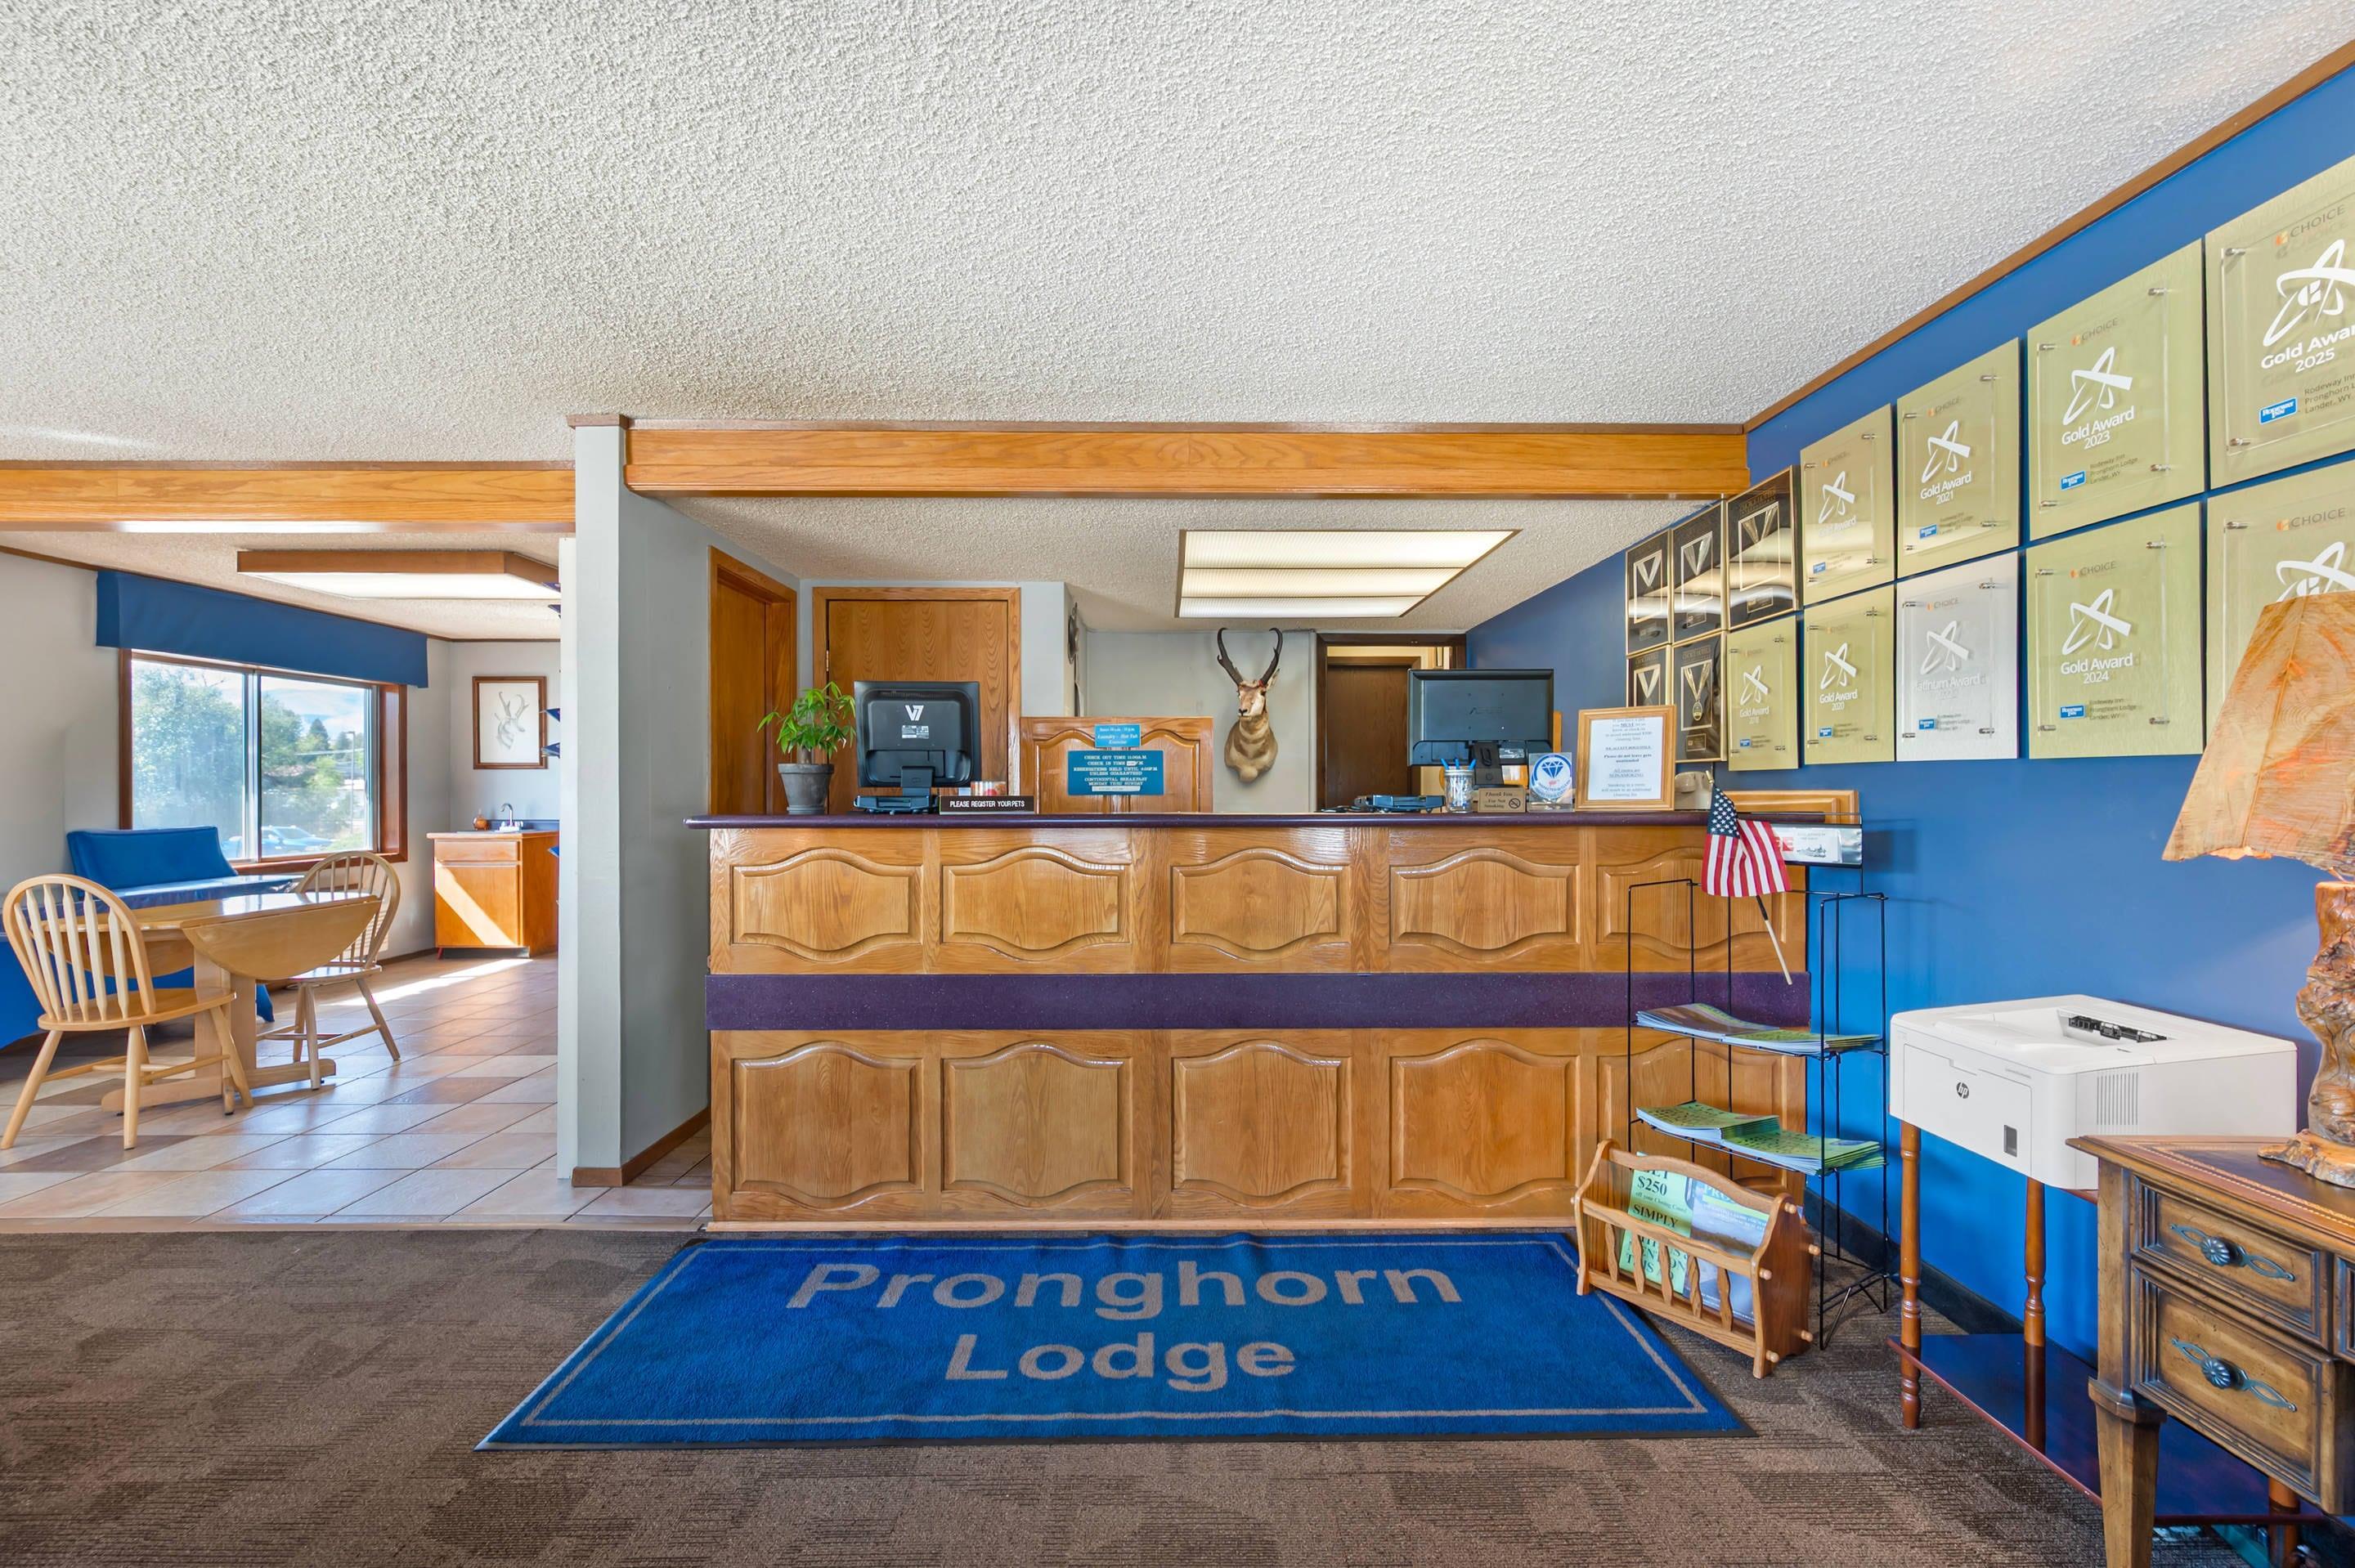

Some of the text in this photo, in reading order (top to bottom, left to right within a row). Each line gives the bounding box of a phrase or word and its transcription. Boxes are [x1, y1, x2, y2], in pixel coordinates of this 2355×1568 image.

[2290, 204, 2346, 238] CHOICE
[2082, 317, 2119, 342] CHOICE
[2261, 325, 2355, 370] Gold Awa
[2295, 347, 2335, 373] 2025
[2304, 379, 2342, 396] Rodeway
[2304, 384, 2349, 405] Pronghorn
[2061, 405, 2134, 446] Gold Award
[2084, 430, 2111, 449] 2023
[1920, 471, 1971, 500] Gold Award
[1936, 491, 1954, 505] 2021
[2291, 508, 2345, 527] CHOICE
[2080, 561, 2117, 577] CHOICE
[2061, 652, 2133, 674] Gold Award
[1949, 673, 1980, 688] Award
[2083, 670, 2110, 684] 2024
[1819, 688, 1858, 704] Gold Award
[905, 705, 924, 721] V7
[1957, 1082, 1969, 1099] hp
[1637, 1176, 1667, 1196] $250
[1632, 1203, 1679, 1228] SIMPLY
[785, 1261, 1462, 1320] Pronghorn
[944, 1333, 1297, 1392] Lodge
